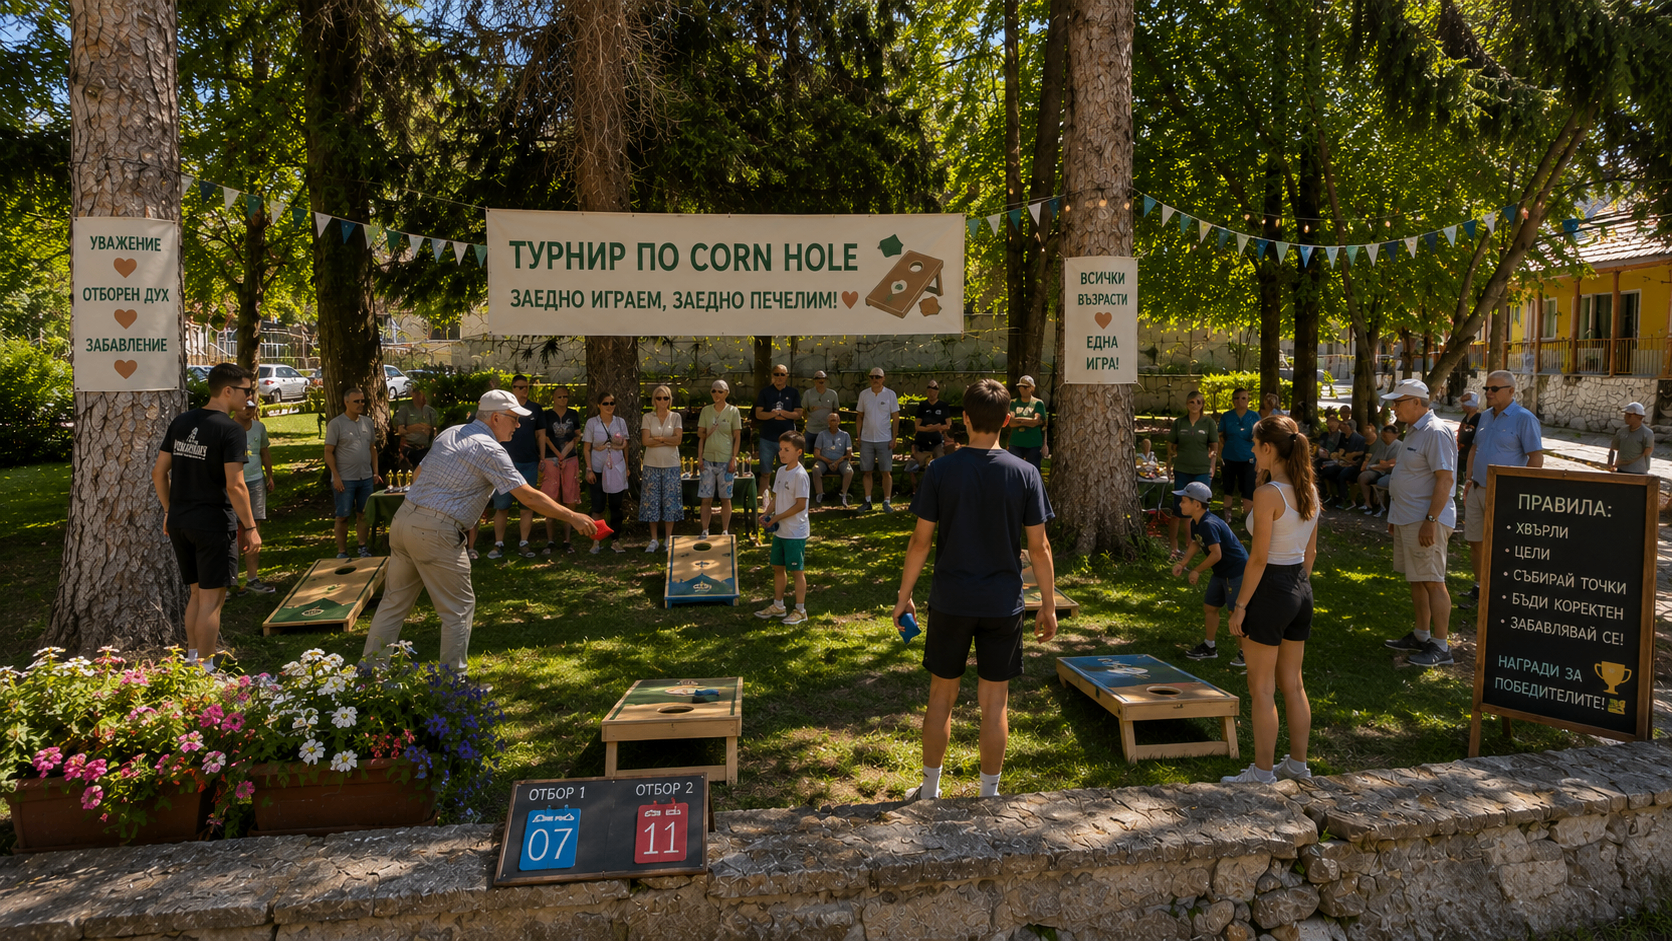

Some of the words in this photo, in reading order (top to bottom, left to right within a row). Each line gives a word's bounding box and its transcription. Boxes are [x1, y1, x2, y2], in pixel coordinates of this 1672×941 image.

[90, 236, 162, 252] УВАЖЕНИЕ
[509, 240, 626, 271] ТУРНИР
[637, 242, 680, 272] ПО
[690, 242, 772, 272] CORN
[784, 243, 858, 272] HOLE
[1080, 272, 1125, 285] ВСИЧКИ
[83, 287, 140, 302] ОТБОРЕН
[144, 288, 170, 304] ДУХ
[510, 289, 585, 312] ЗАЕДНО
[591, 290, 667, 312] ИГРАЕМ,
[672, 291, 745, 313] ЗАЕДНО
[750, 291, 838, 310] ПЕЧЕЛИМ!
[1078, 293, 1128, 306] ВЪЗРАСТИ
[85, 338, 168, 353] ЗАБАВЛЕНИЕ
[1086, 335, 1119, 351] ЕДНА
[1086, 357, 1119, 371] ИГРА!
[1518, 493, 1612, 517] ПРАВИЛА:
[1516, 522, 1569, 540] ХВЪРЛИ
[1514, 545, 1551, 561] ЦЕЛИ
[1513, 569, 1575, 588] СЪБИРАЙ
[1580, 577, 1627, 595] ТОЧКИ
[1512, 592, 1549, 610] БЪДИ
[1554, 598, 1624, 620] КОРЕКТЕН
[1510, 616, 1597, 642] ЗАБАВЛЯВАЙ
[1602, 631, 1624, 646] СЕ!
[1498, 654, 1560, 678] НАГРАДИ
[1564, 666, 1583, 683] ЗА
[1494, 676, 1606, 711] ПОБЕДИТЕЛИТЕ!
[528, 787, 575, 801] ОТБОР
[578, 786, 586, 799] 1
[635, 782, 682, 797] ОТБОР
[685, 781, 694, 794] 2
[527, 828, 574, 862] 07
[643, 821, 680, 855] 11
